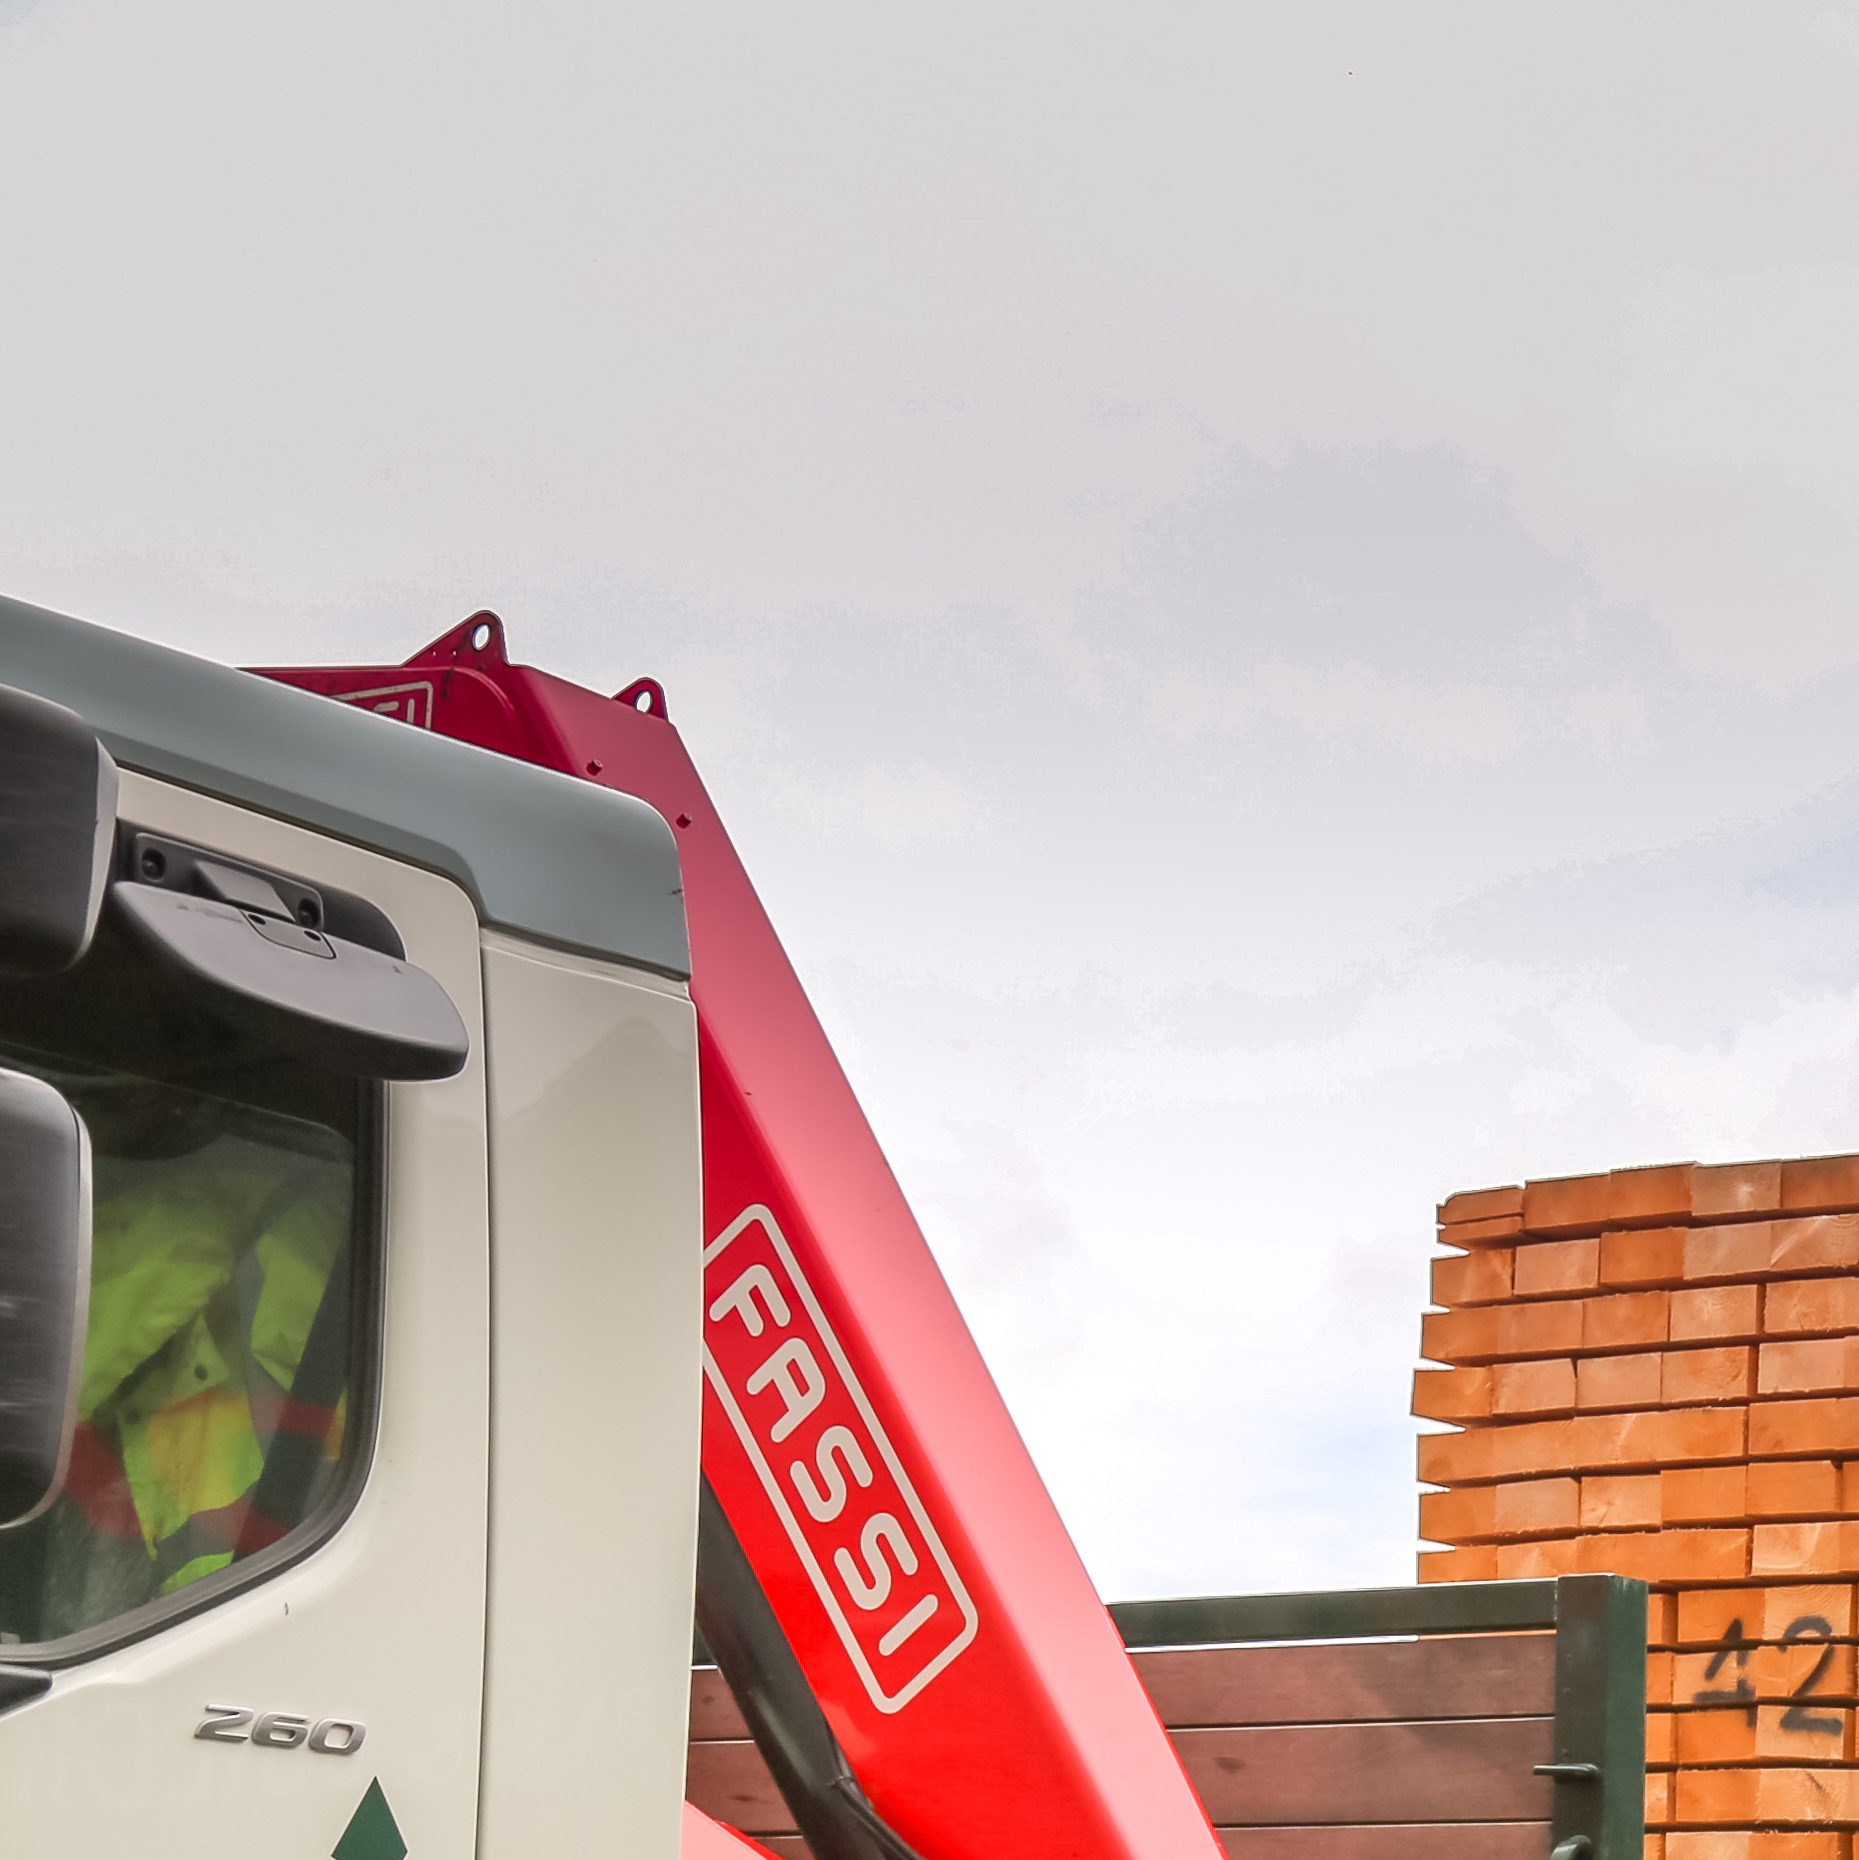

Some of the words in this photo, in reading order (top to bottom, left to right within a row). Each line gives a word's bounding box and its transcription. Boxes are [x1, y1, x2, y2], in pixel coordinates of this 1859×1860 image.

[709, 1263, 939, 1656] FASSI
[194, 1703, 367, 1756] 260
[1693, 1616, 1844, 1736] 42
